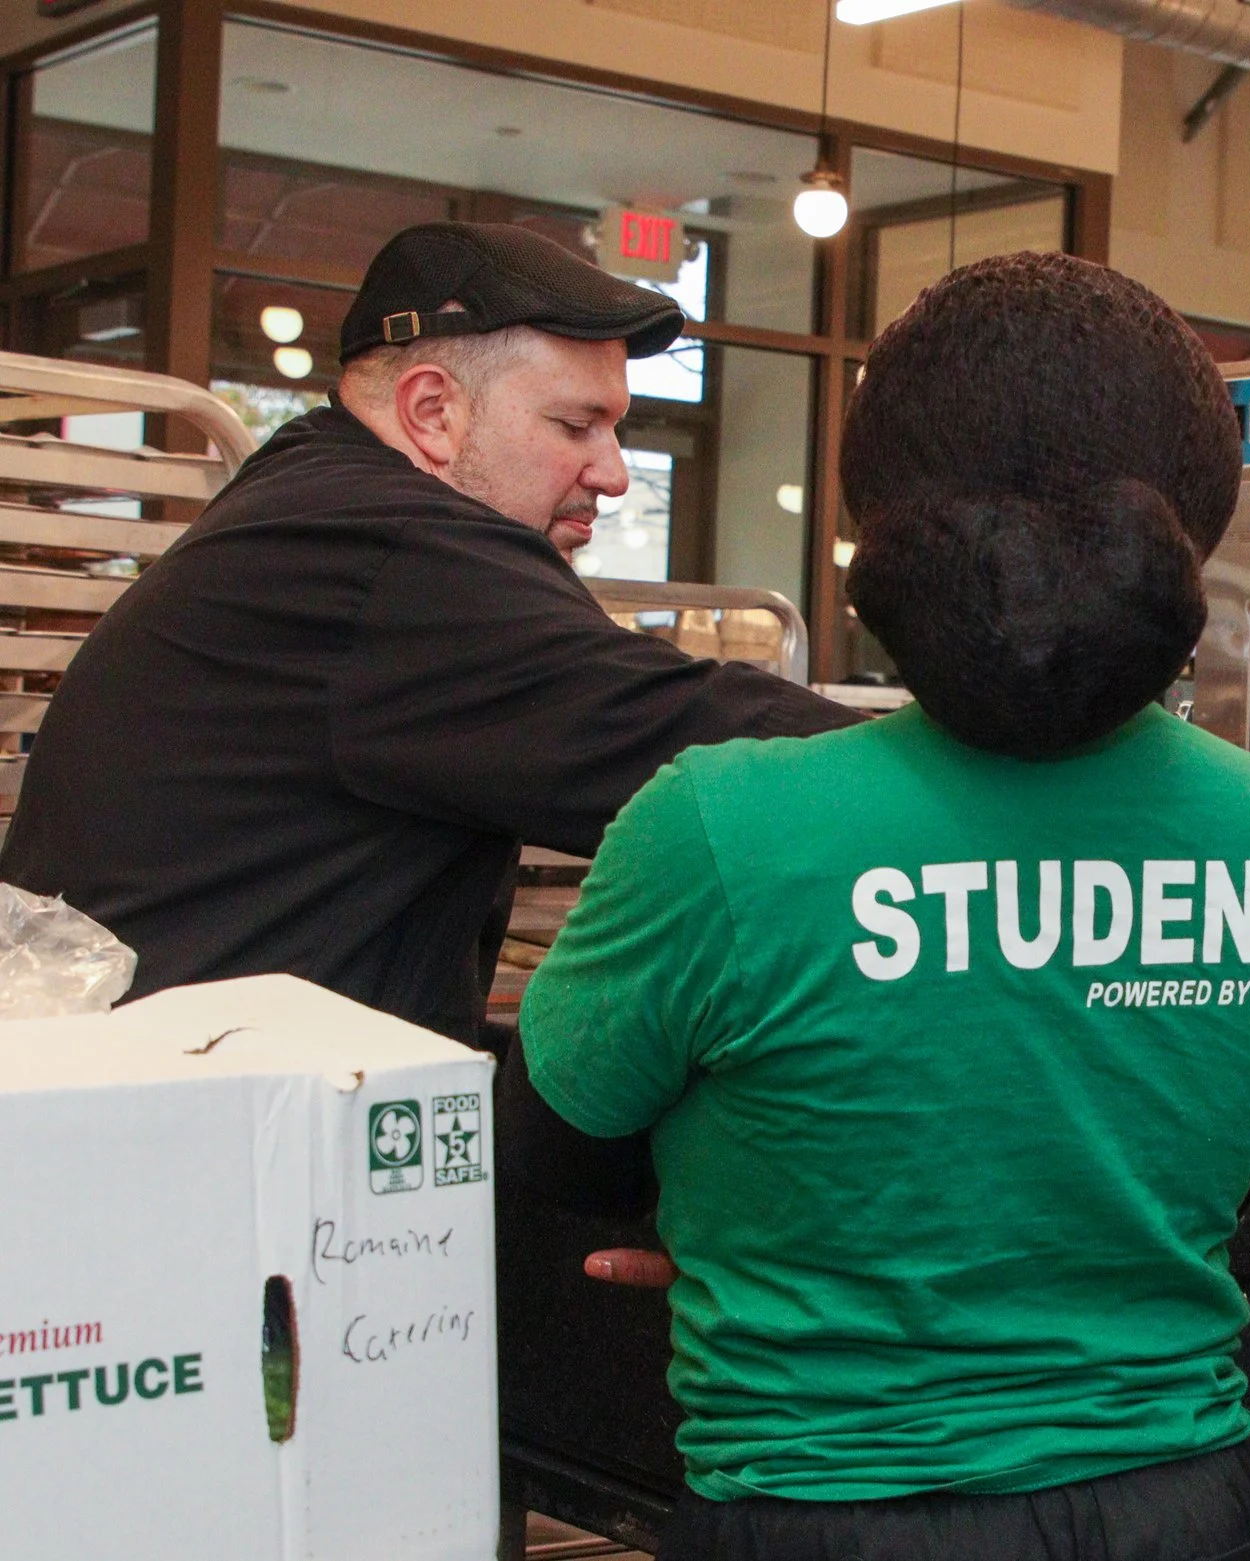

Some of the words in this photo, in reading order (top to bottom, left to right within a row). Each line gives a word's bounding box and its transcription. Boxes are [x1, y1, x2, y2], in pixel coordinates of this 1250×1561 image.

[622, 211, 676, 262] EXIT
[1086, 979, 1213, 1008] POWERED
[434, 1096, 479, 1113] FOOD
[449, 1131, 466, 1156] 5
[435, 1166, 481, 1185] SAFE
